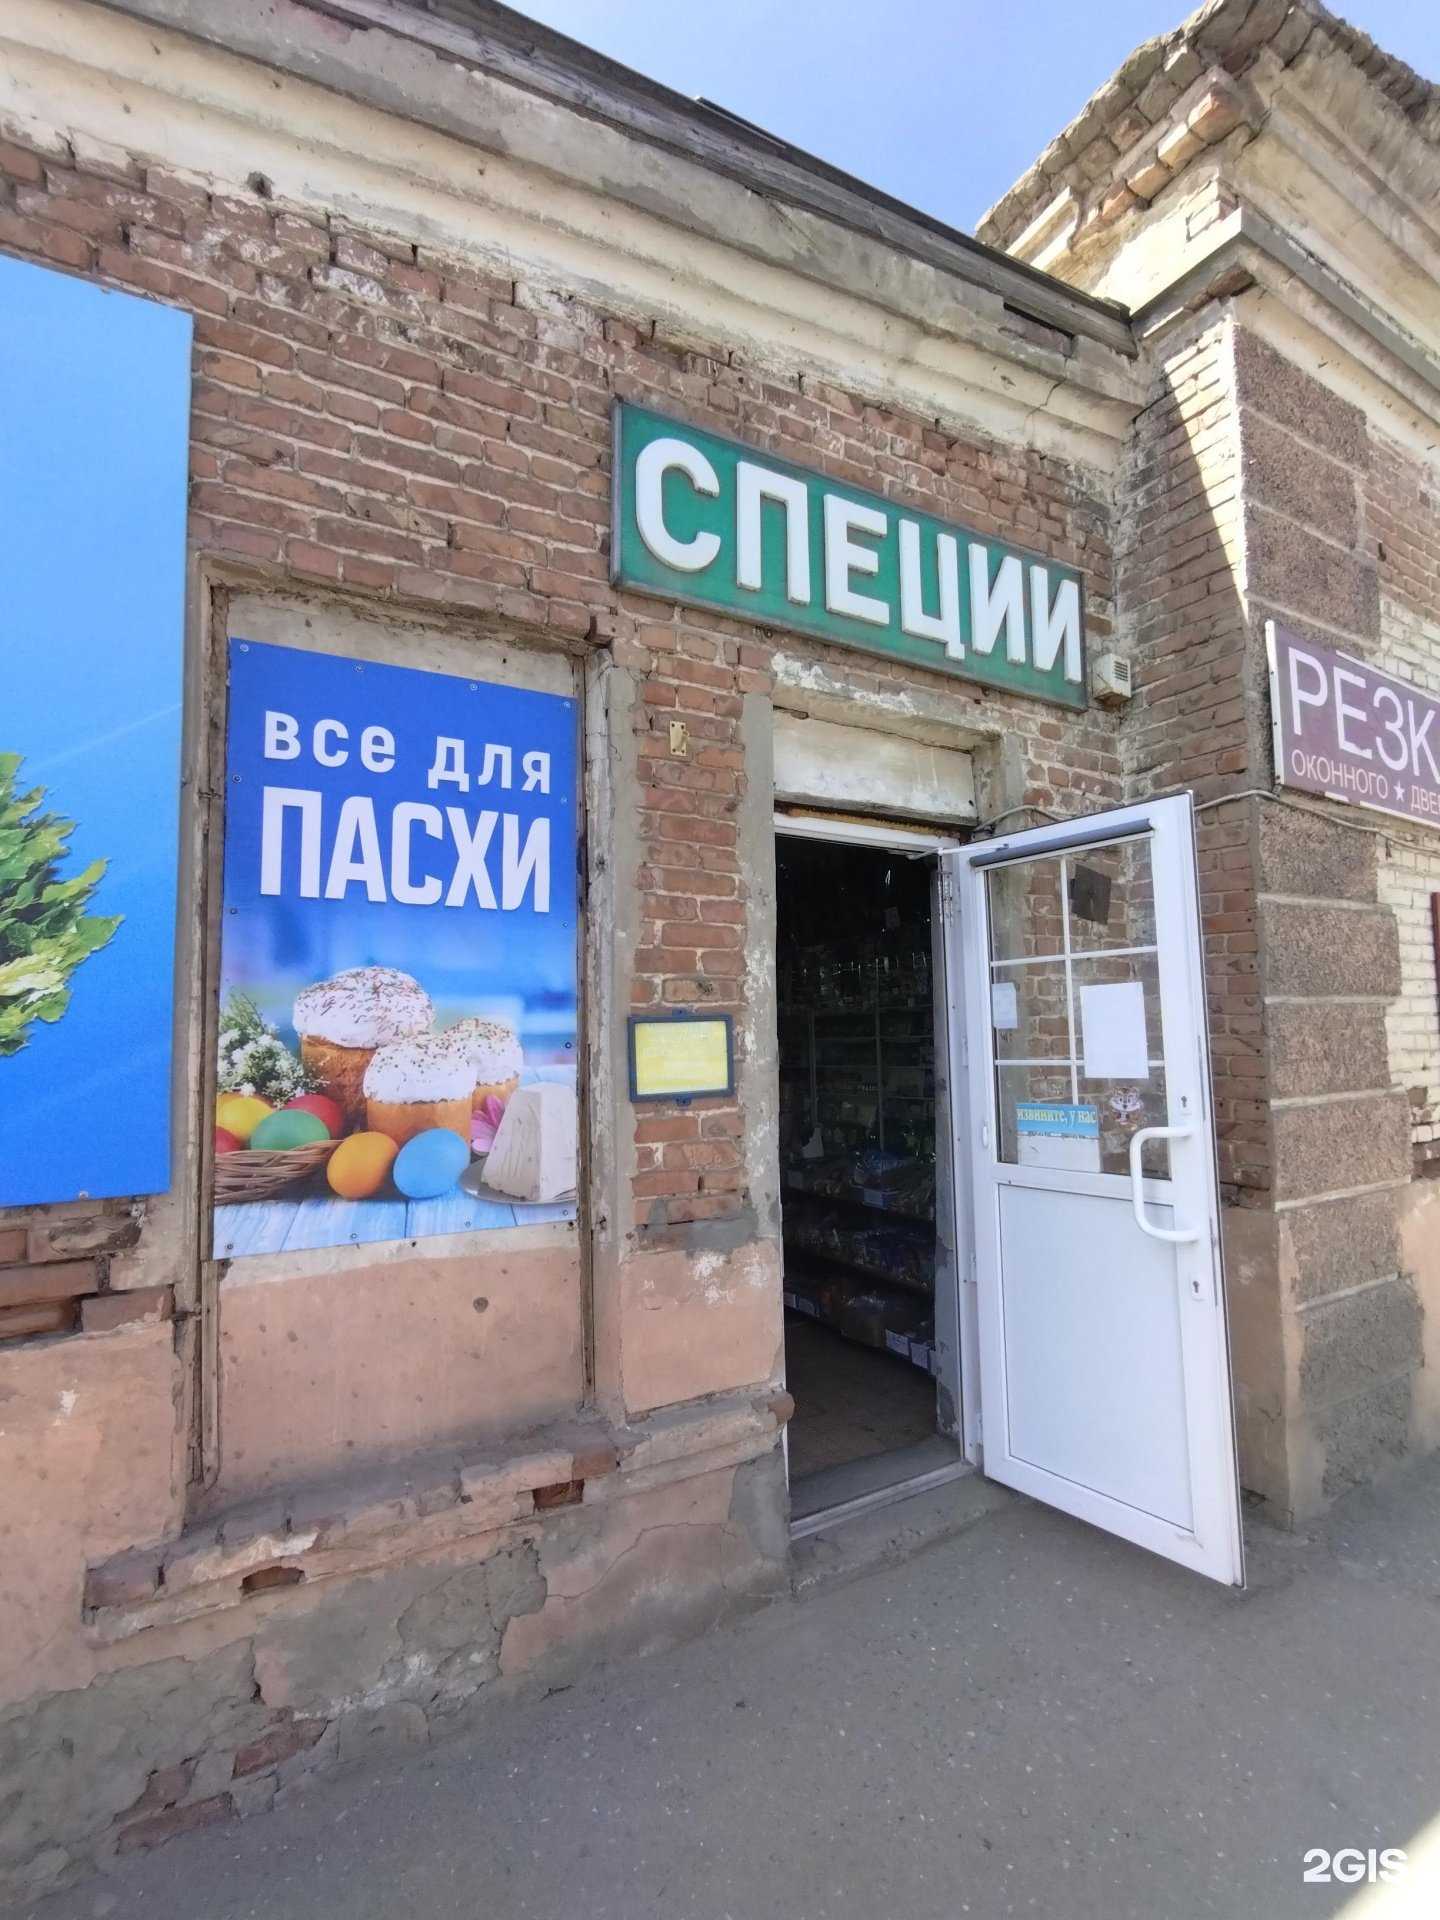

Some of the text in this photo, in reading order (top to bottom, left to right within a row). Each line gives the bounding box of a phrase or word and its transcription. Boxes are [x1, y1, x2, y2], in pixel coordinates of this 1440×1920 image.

[636, 438, 1083, 684] СПЕЦИИ
[263, 710, 551, 793] все для
[1291, 749, 1440, 817] ОКОННОГО ДВЕ
[260, 785, 551, 913] ПАСХИ
